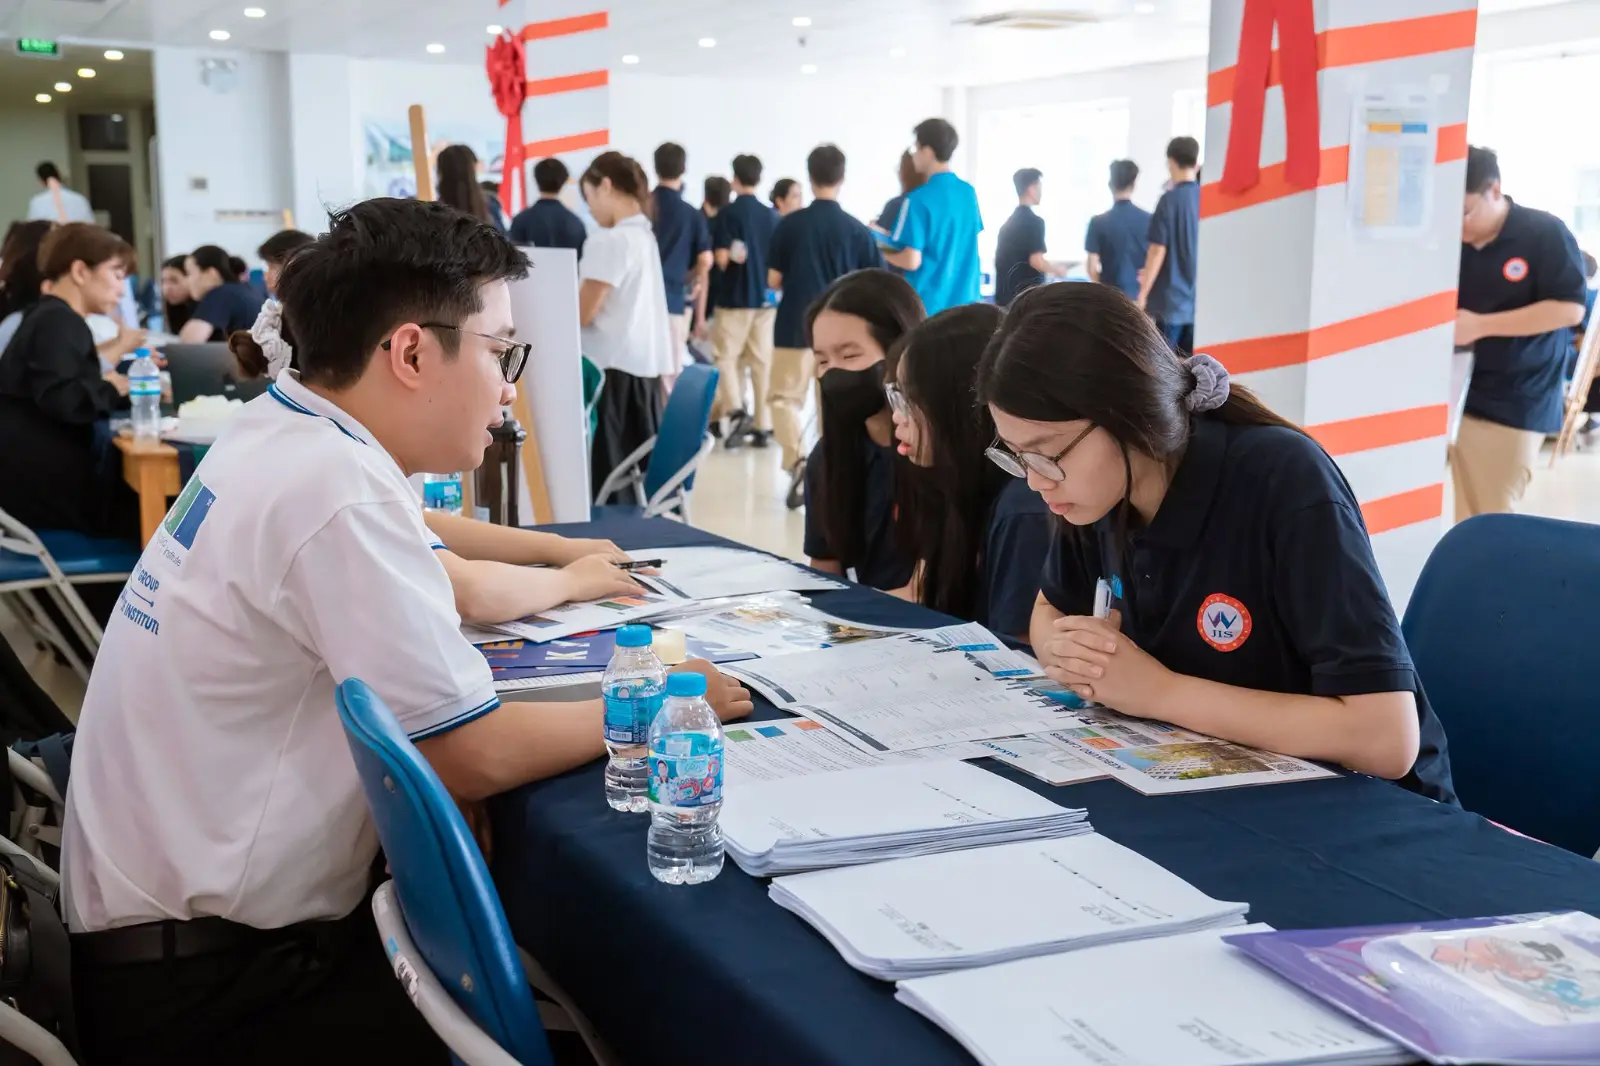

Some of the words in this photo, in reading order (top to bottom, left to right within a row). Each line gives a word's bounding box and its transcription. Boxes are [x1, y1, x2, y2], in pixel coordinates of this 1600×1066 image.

[138, 569, 159, 592] GROUP
[1211, 629, 1234, 638] JIS
[982, 741, 1022, 759] NAKANO
